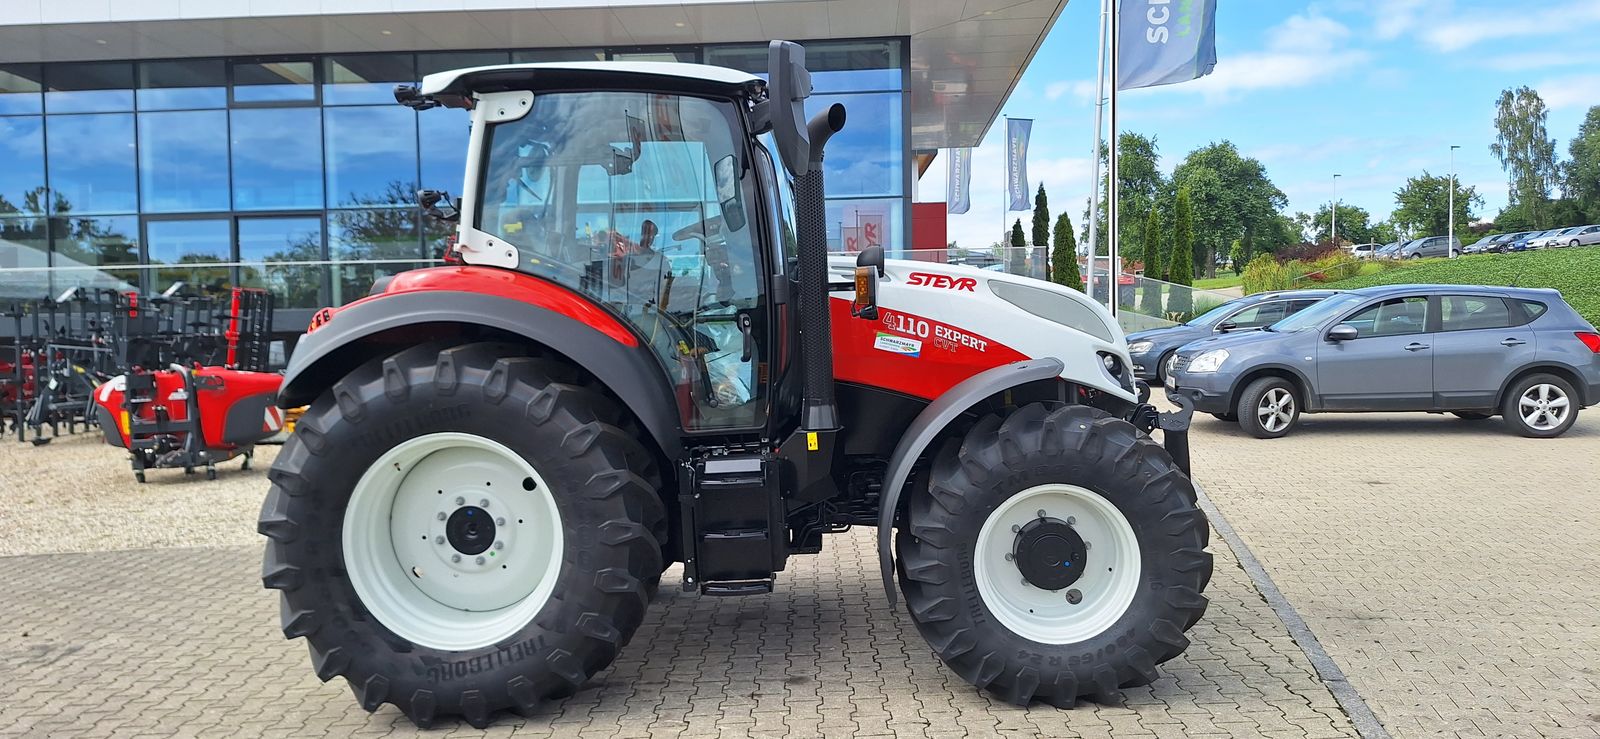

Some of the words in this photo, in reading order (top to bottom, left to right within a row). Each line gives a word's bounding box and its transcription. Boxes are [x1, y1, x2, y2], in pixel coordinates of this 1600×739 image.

[906, 272, 977, 292] STEYR
[883, 311, 930, 338] 4110
[935, 325, 987, 352] EXPERT
[934, 336, 959, 352] CVT
[955, 541, 986, 628] TRELLEBORG
[426, 635, 546, 685] TRELLEBORG
